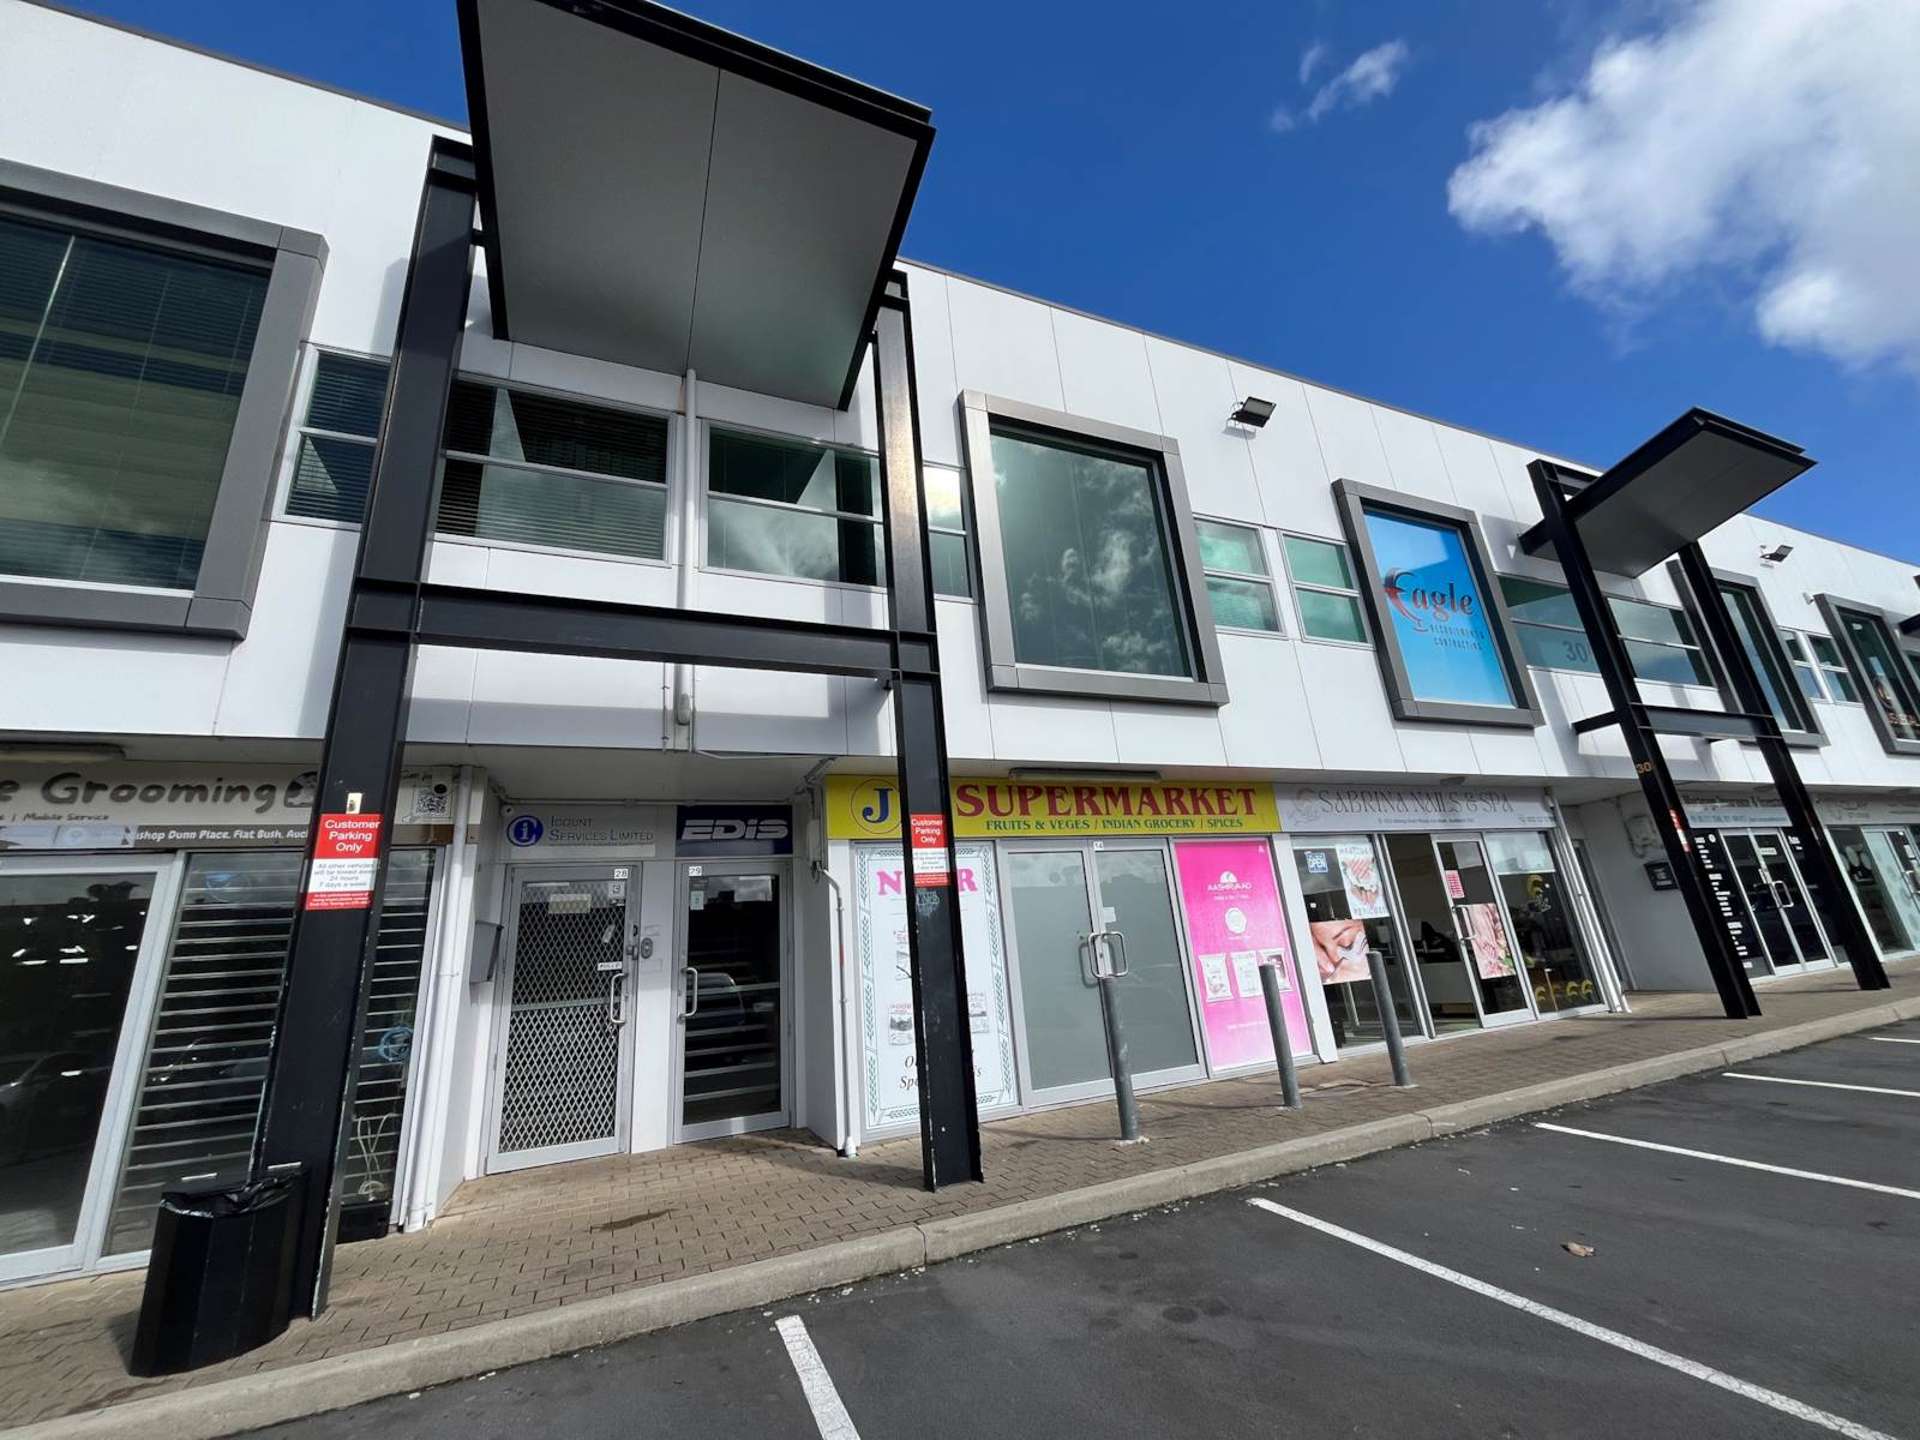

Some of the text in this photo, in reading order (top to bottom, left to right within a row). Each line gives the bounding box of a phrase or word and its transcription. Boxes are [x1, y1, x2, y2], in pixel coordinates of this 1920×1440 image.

[41, 772, 277, 814] Grooming
[956, 783, 1257, 818] SUPERMARKET
[1318, 790, 1409, 813] SABRINA
[1480, 791, 1515, 813] SPA
[325, 819, 381, 829] Customer
[911, 818, 942, 826] Customer
[986, 819, 1031, 831] FRUITS
[1034, 819, 1046, 830] &
[1050, 819, 1090, 830] VEGES
[1102, 818, 1141, 830] INDIAN
[1144, 818, 1195, 829] GROCERY
[1207, 818, 1243, 828] SPICES
[329, 831, 373, 843] Parking
[915, 827, 941, 836] Parking
[920, 835, 937, 844] Only
[335, 842, 363, 853] Only
